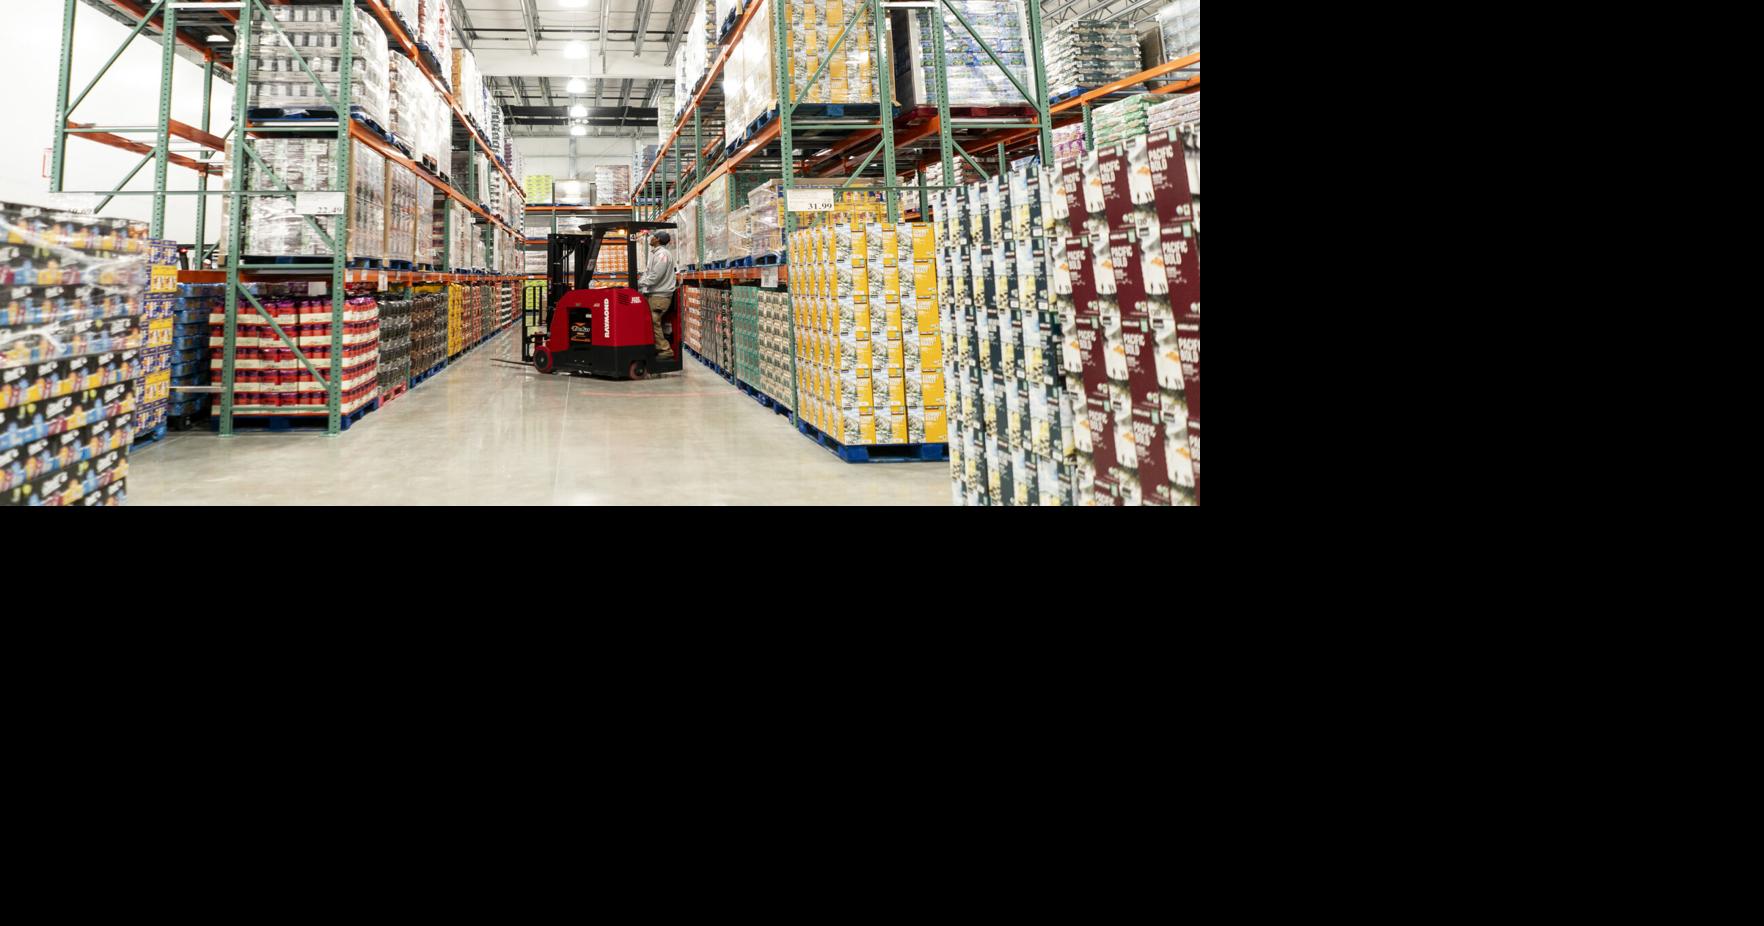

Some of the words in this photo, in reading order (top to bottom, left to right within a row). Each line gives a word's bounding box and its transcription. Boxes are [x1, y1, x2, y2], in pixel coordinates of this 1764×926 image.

[1148, 145, 1173, 161] PACIFIC
[1099, 159, 1120, 173] PACIFIC
[808, 202, 832, 210] 31.99
[1110, 245, 1133, 258] PACIFIC
[1162, 240, 1188, 254] PACIFIC
[1123, 333, 1145, 347] PACIFIC
